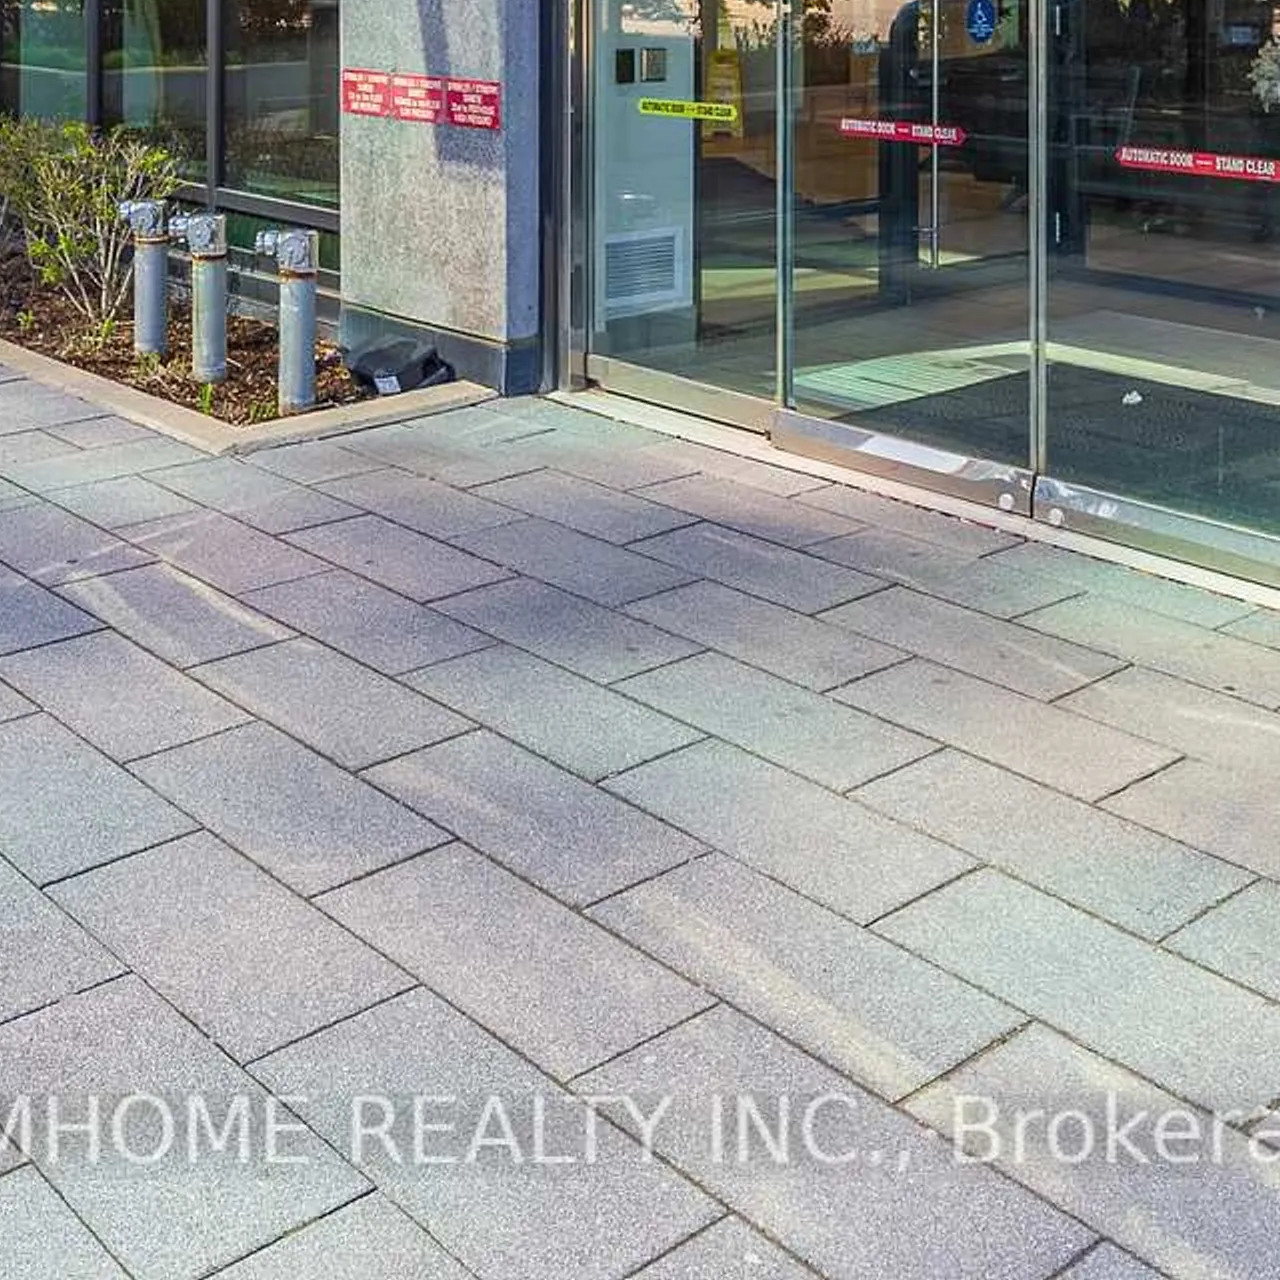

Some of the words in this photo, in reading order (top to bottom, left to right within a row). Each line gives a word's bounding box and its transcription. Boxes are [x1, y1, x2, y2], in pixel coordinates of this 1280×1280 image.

[1121, 147, 1168, 165] AUTOMATIC
[1169, 150, 1194, 167] DOOR
[1215, 156, 1244, 172] STAND
[1245, 160, 1276, 176] CLEAR
